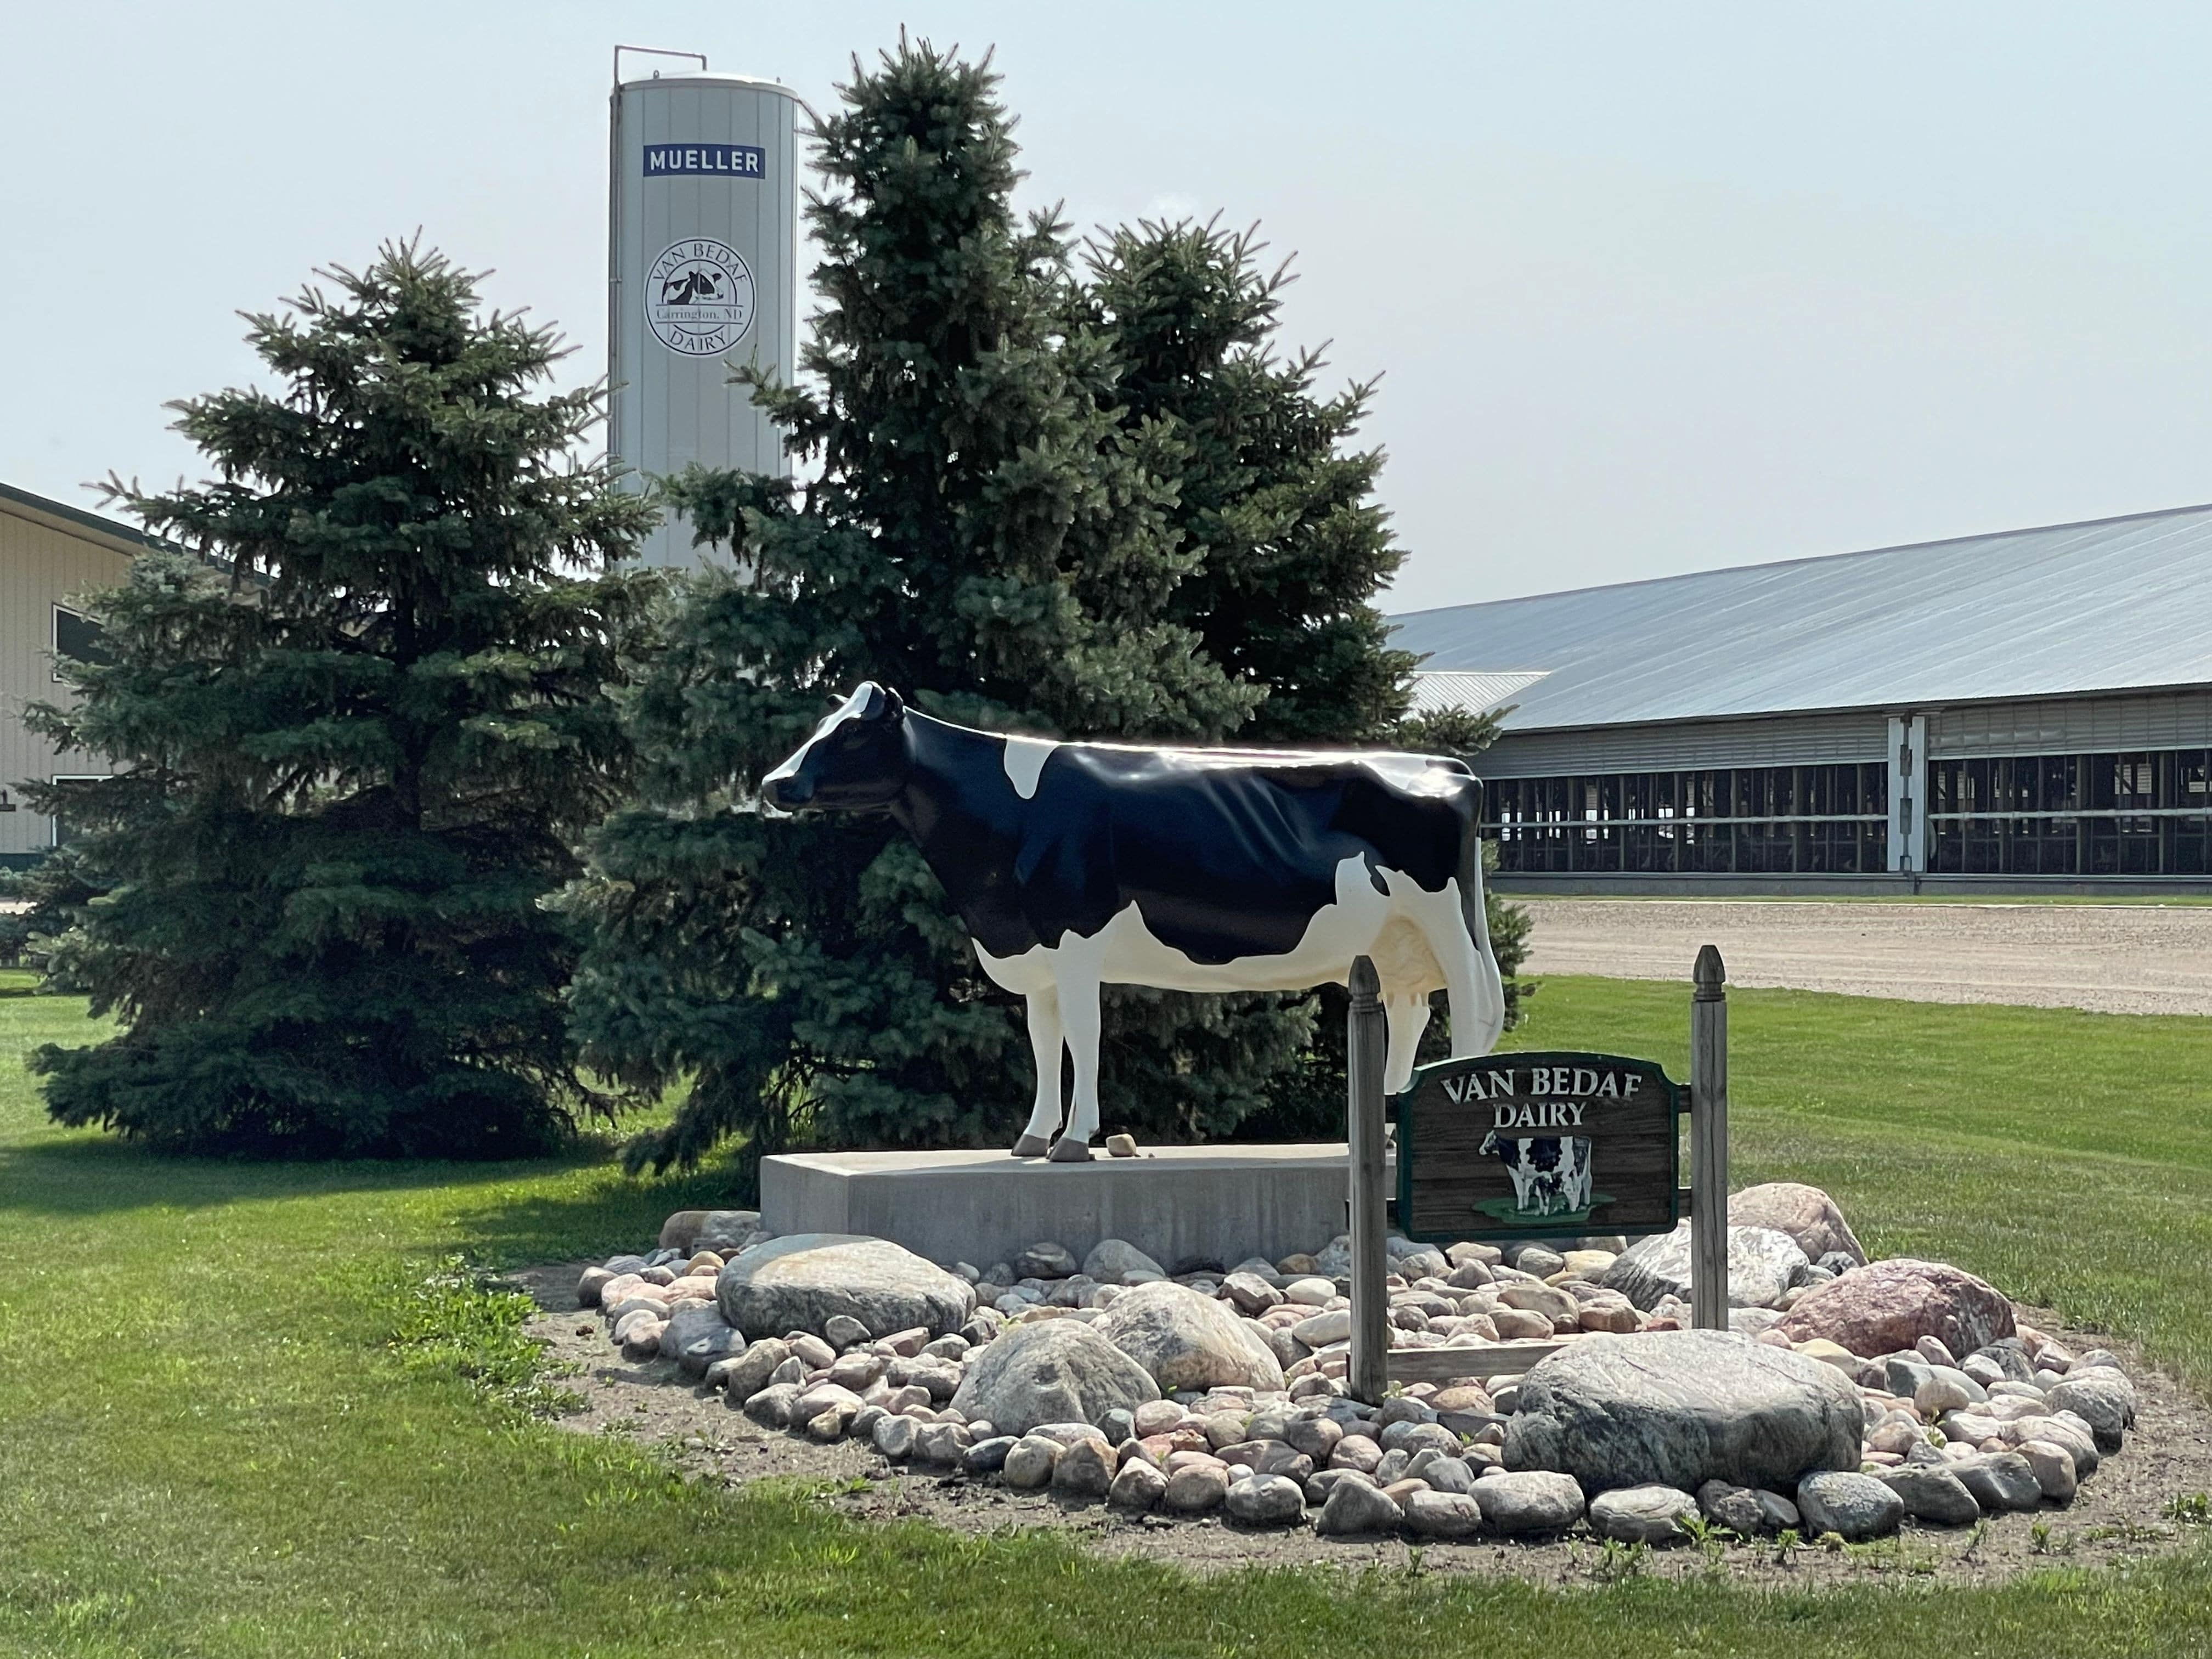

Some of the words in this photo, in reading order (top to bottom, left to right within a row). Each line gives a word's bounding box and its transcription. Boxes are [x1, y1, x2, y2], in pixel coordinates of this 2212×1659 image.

[650, 150, 759, 172] MUELLER
[653, 248, 685, 282] VAN
[693, 243, 748, 283] BEDAF
[724, 308, 742, 319] ND
[669, 331, 726, 351] DAIRY
[1441, 1069, 1514, 1104] VAN
[1531, 1068, 1642, 1101] BEDAF
[1493, 1102, 1587, 1128] DAIRY
